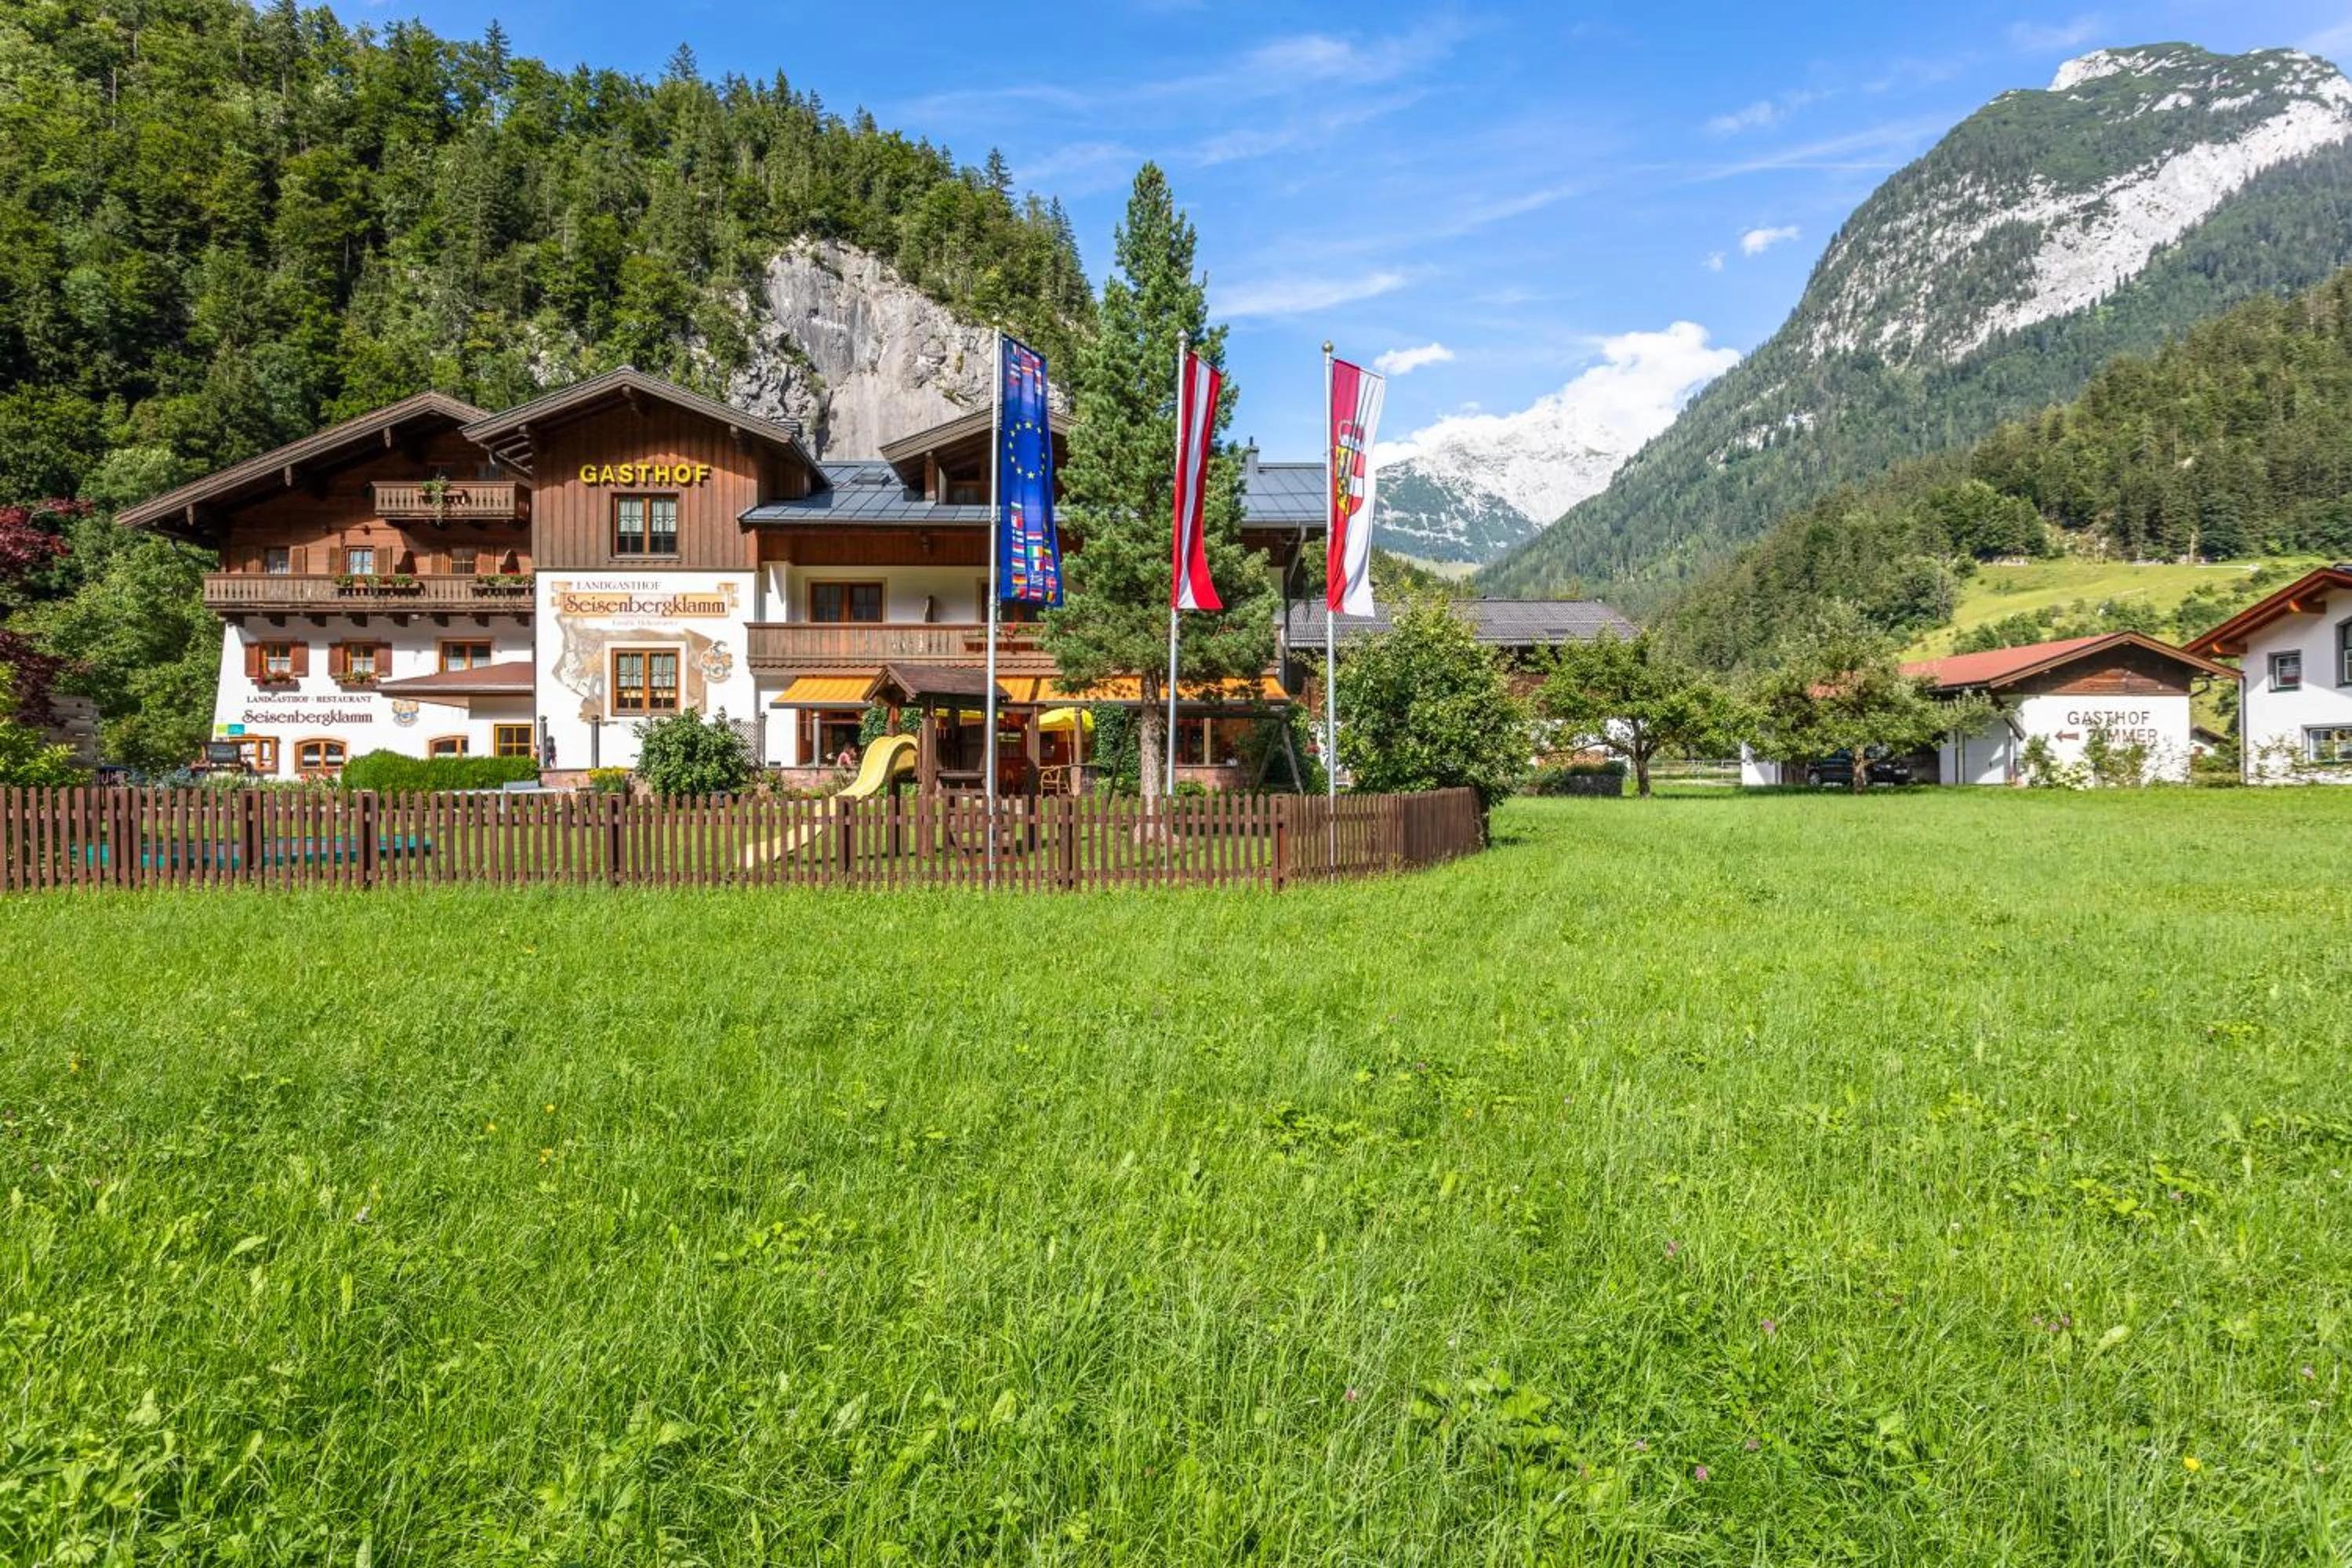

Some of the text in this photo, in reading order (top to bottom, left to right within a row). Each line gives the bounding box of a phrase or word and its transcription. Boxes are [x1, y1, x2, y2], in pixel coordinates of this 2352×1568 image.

[579, 464, 710, 485] GASTHOF
[576, 581, 662, 590] LANDGASTHOF
[564, 595, 725, 617] Seisenbergklamm
[242, 710, 372, 726] Seisenbergklamm
[2067, 711, 2150, 725] GASTHOF
[2086, 728, 2158, 743] ZMMER
